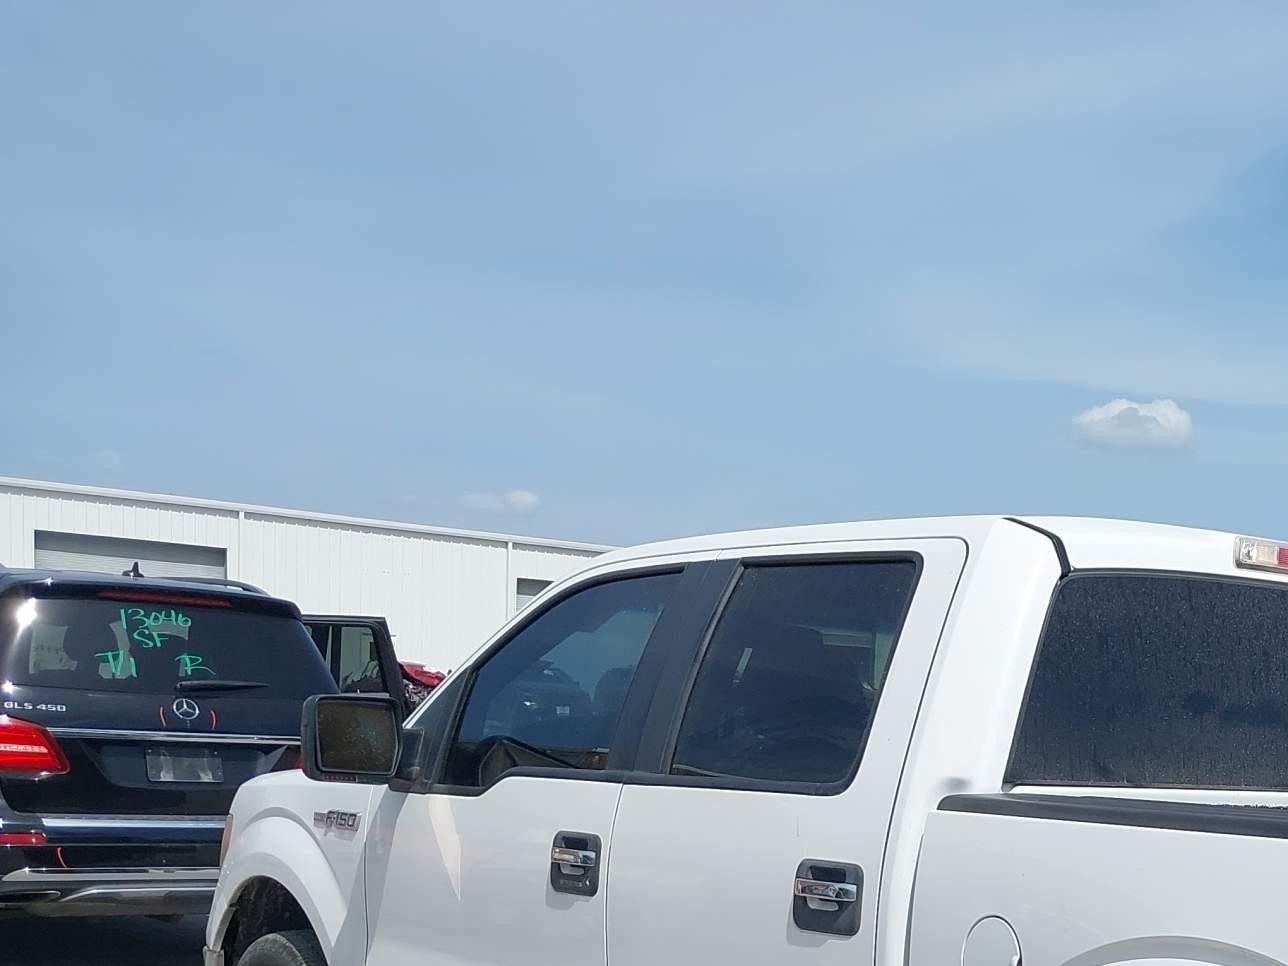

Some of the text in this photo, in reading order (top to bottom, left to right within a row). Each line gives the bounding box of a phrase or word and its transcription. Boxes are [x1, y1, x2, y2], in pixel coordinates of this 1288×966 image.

[120, 608, 191, 629] 13046
[133, 629, 168, 648] SF
[36, 703, 67, 712] 450
